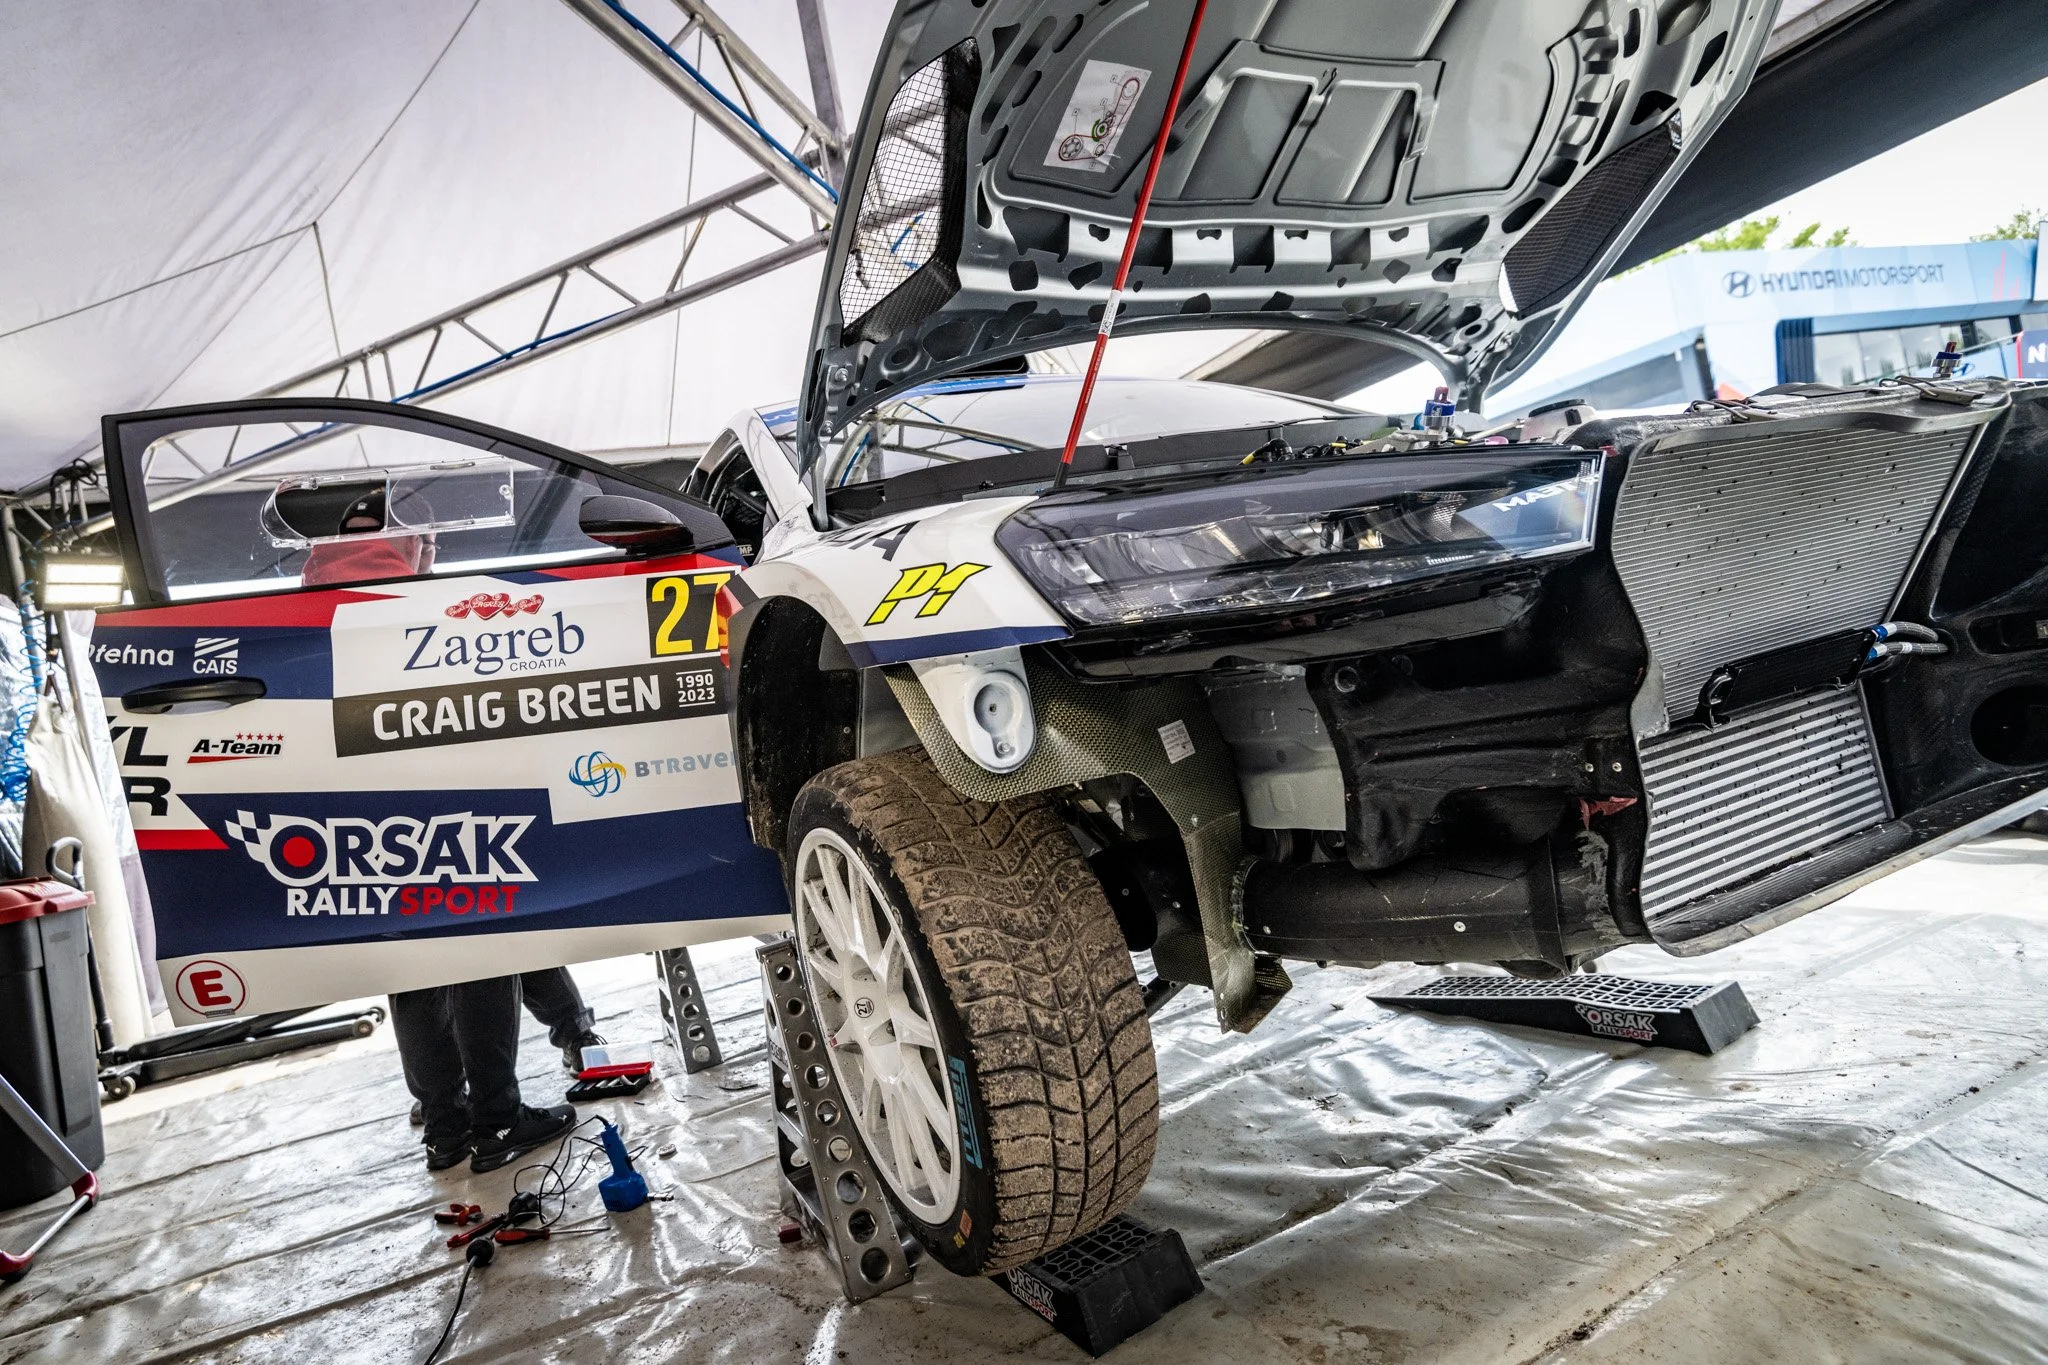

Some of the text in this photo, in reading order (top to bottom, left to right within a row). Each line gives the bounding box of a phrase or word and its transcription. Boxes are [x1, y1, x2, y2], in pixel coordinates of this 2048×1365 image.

[652, 573, 731, 655] 27
[403, 611, 585, 676] Zagreb
[193, 659, 238, 675] CAIS
[510, 658, 567, 672] CROATIA
[676, 673, 714, 688] 1990
[373, 674, 661, 741] CRAIG BREEN
[678, 687, 715, 703] 2023
[192, 739, 282, 756] A-Team
[190, 970, 231, 1006] E
[948, 1055, 983, 1169] PIRELLI
